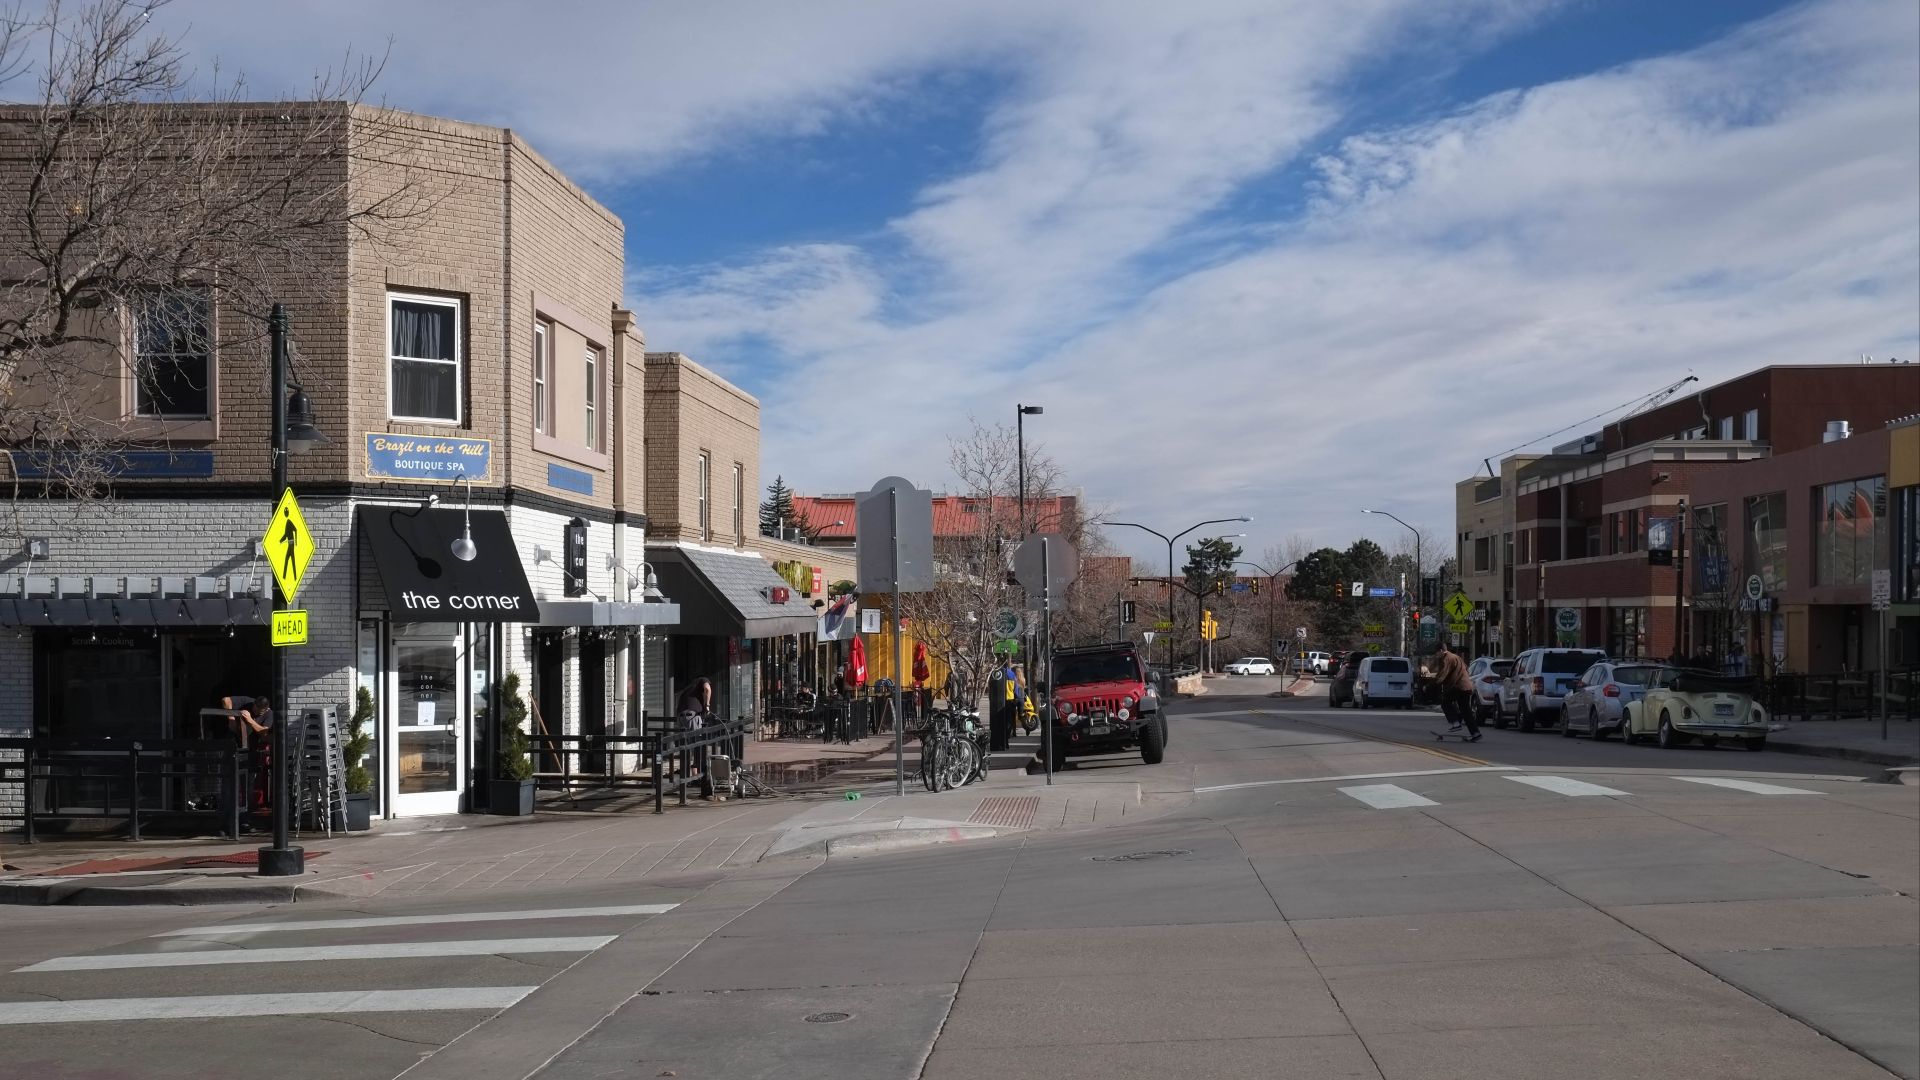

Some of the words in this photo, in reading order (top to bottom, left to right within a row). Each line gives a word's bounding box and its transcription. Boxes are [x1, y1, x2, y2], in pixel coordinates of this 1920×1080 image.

[373, 438, 415, 456] Brazil
[416, 445, 431, 453] on
[434, 443, 455, 454] the
[458, 443, 485, 456] Hill
[395, 459, 444, 470] BOUTIQUE
[446, 462, 465, 471] SPA
[402, 590, 441, 609] the
[449, 595, 520, 610] corner
[277, 620, 303, 636] AHEAD
[71, 636, 99, 646] Scratch
[102, 636, 134, 647] Cooking
